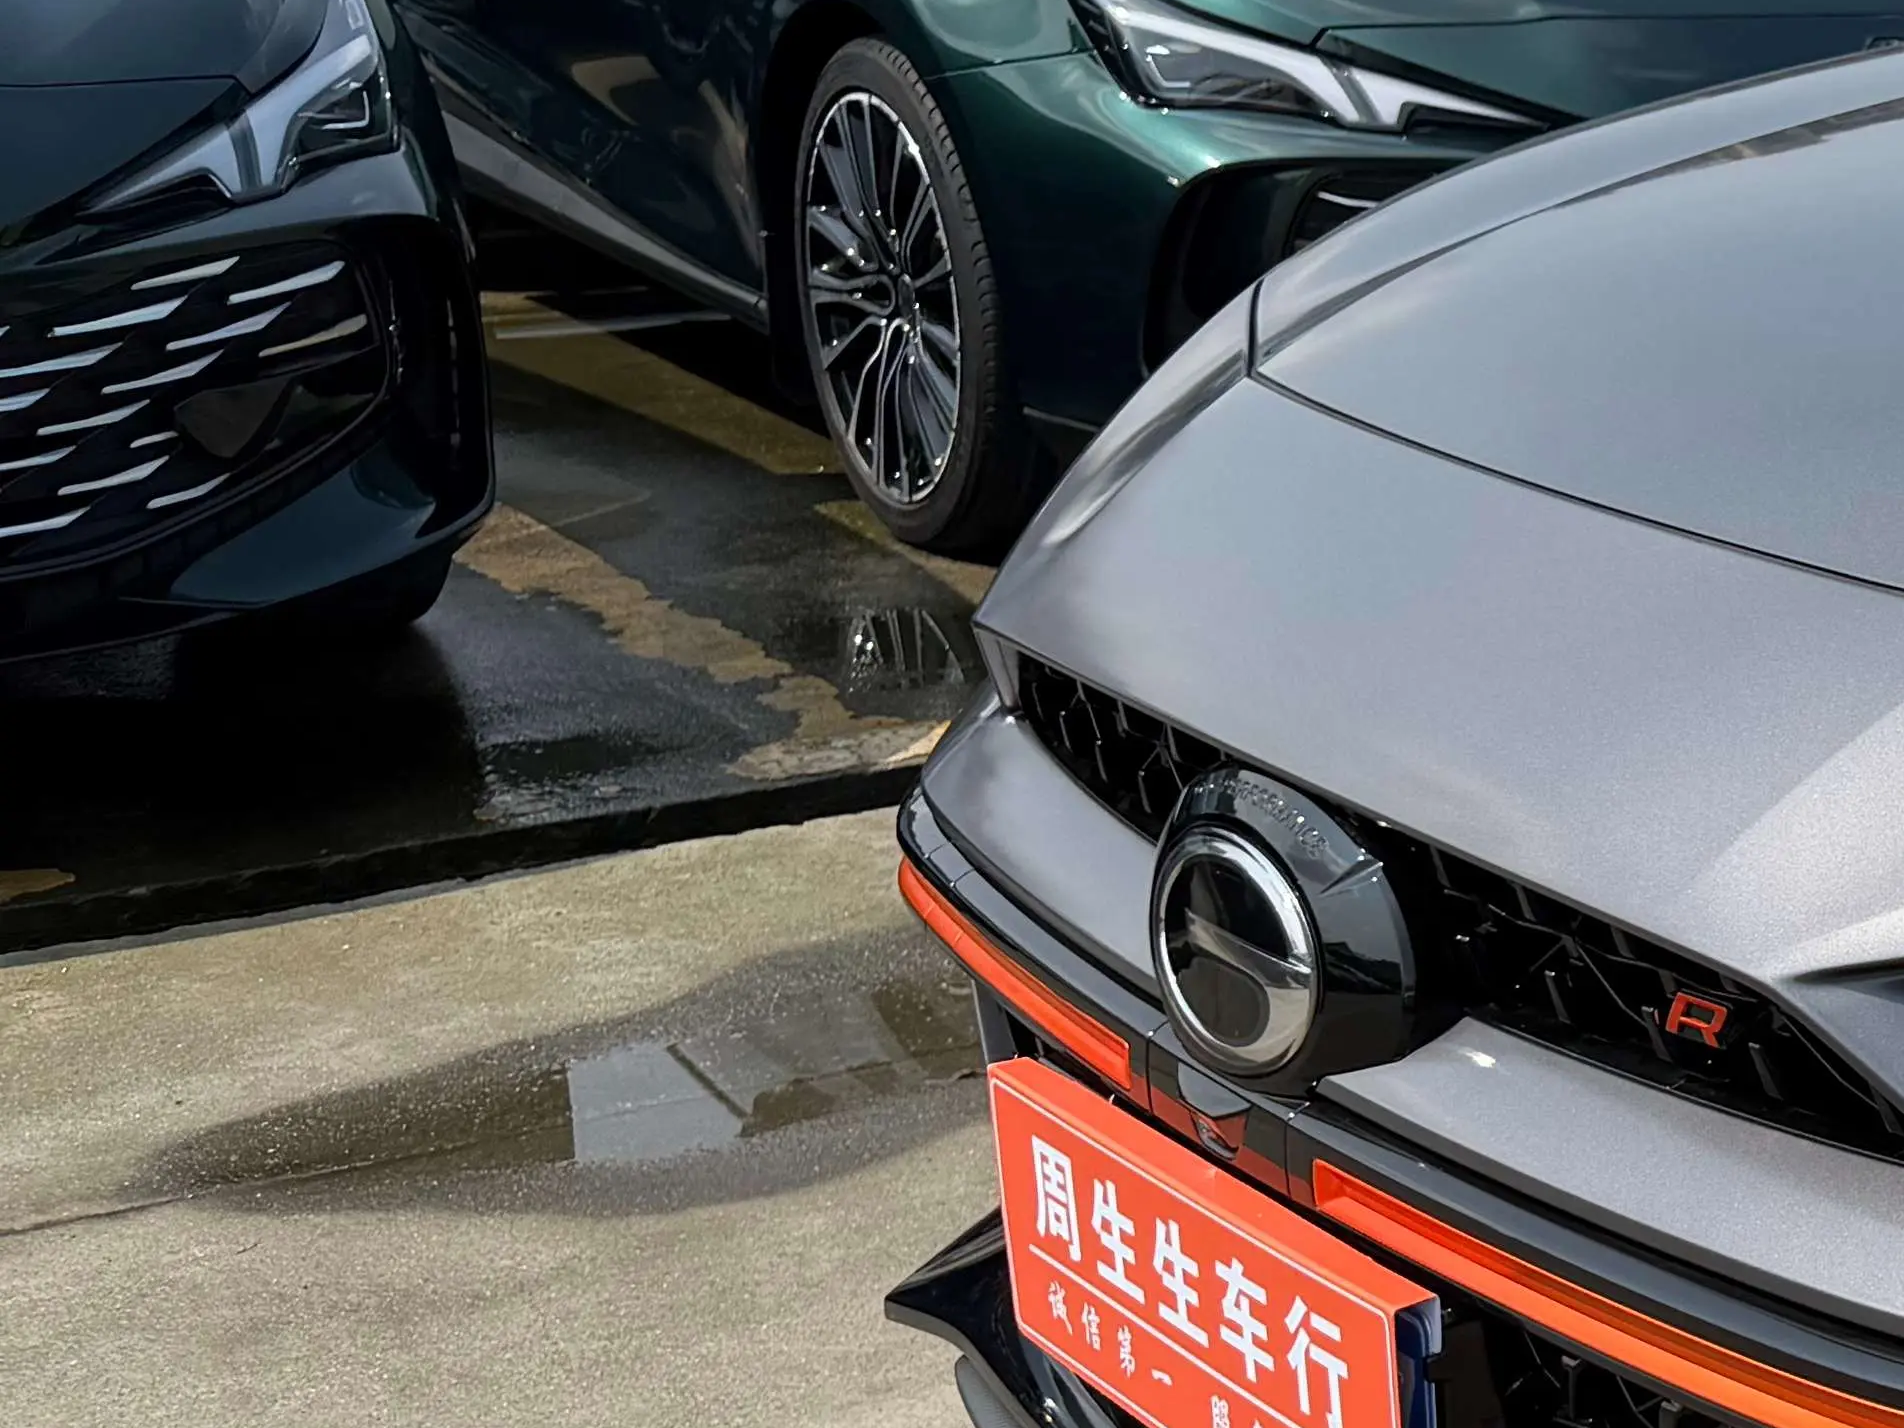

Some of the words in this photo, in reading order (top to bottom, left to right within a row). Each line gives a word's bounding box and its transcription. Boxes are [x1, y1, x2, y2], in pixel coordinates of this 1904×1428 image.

[1665, 992, 1728, 1049] R
[1048, 1280, 1173, 1386] 诚信第一
